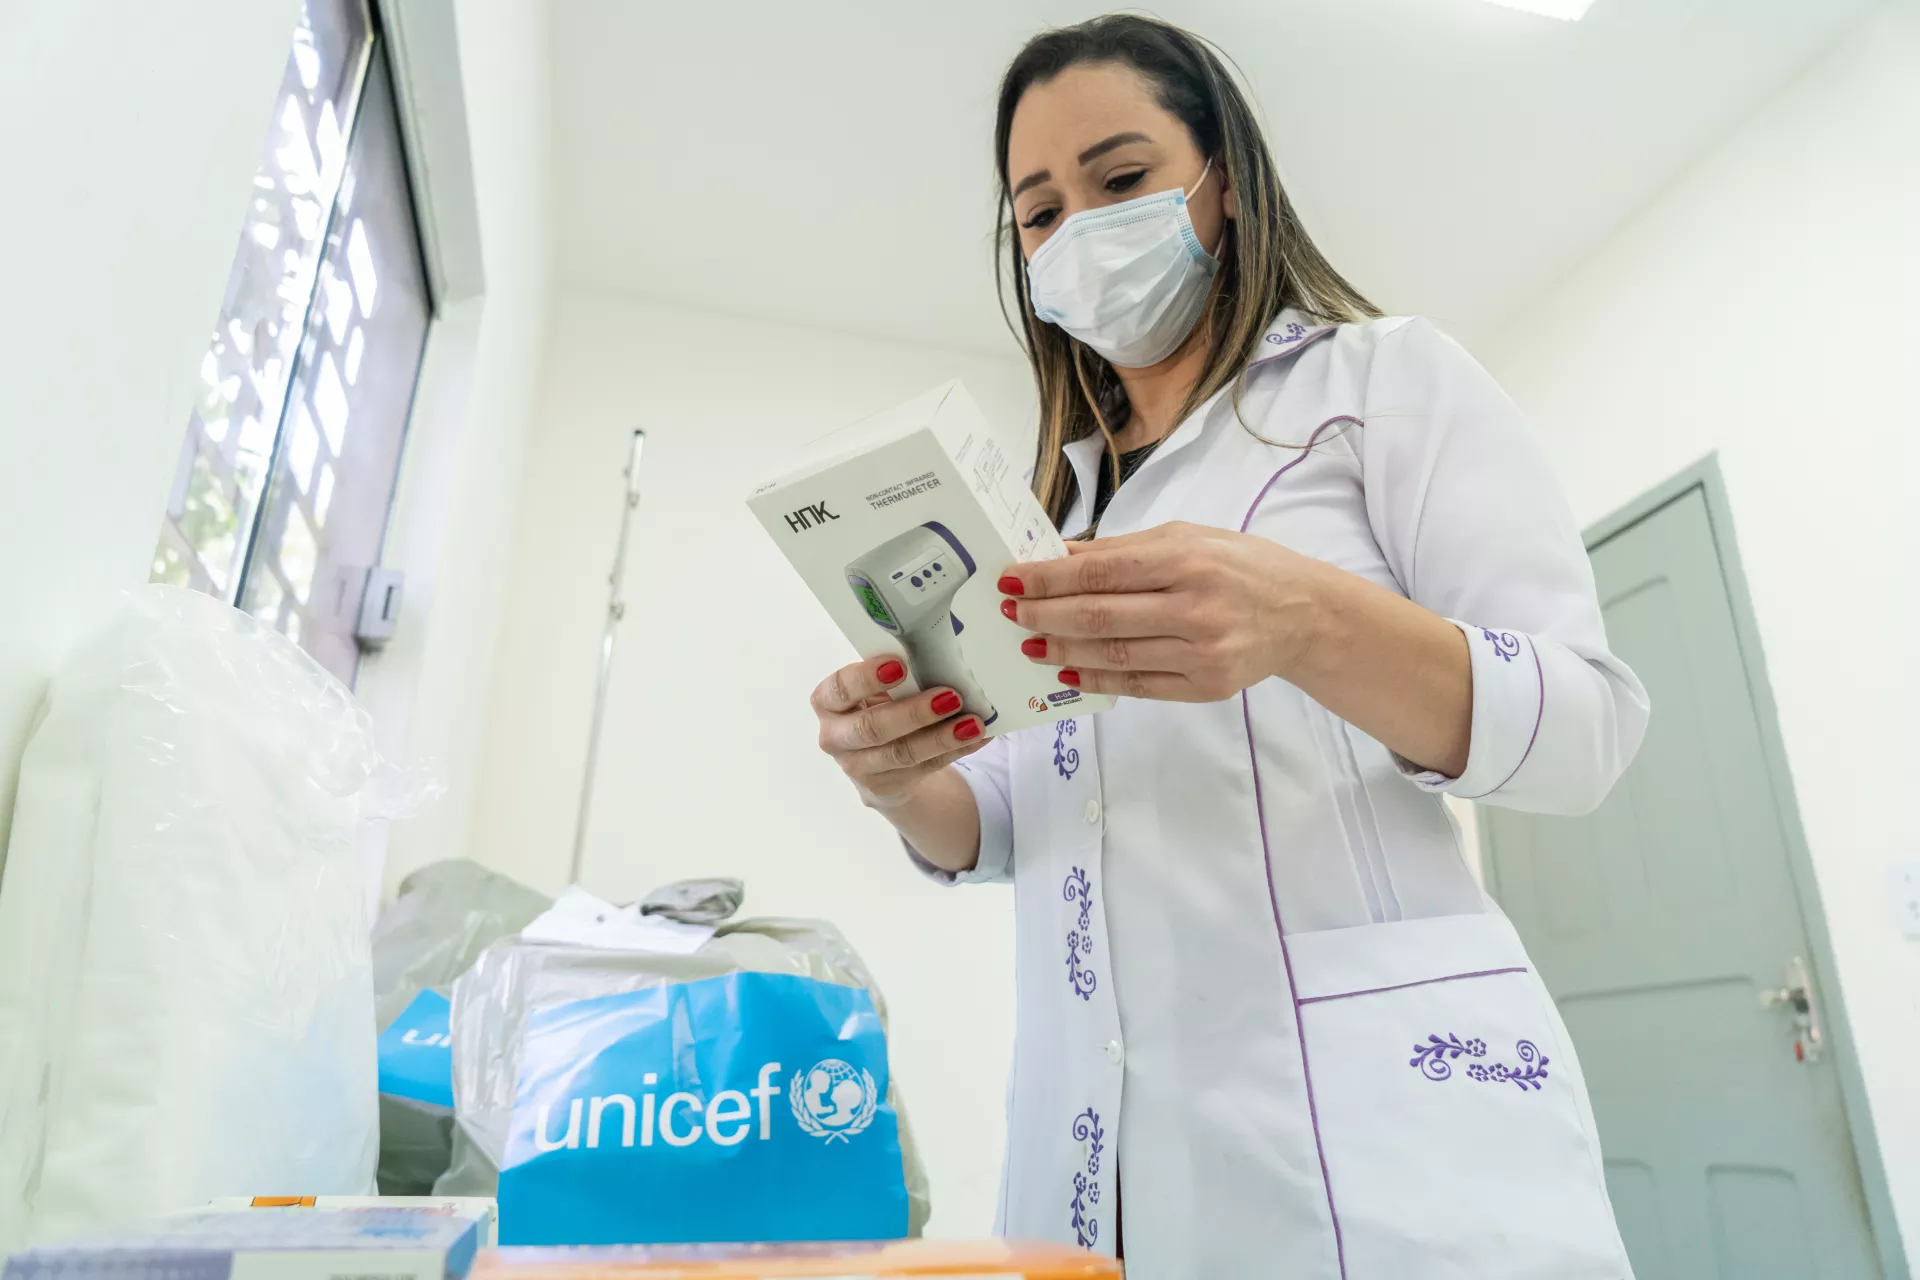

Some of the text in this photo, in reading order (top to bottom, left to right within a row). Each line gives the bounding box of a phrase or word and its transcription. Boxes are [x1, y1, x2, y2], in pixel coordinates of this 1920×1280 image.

[865, 471, 936, 501] NON-CONTACT INFRARED
[869, 478, 942, 511] THERMOMETER
[534, 1061, 782, 1152] unicef
